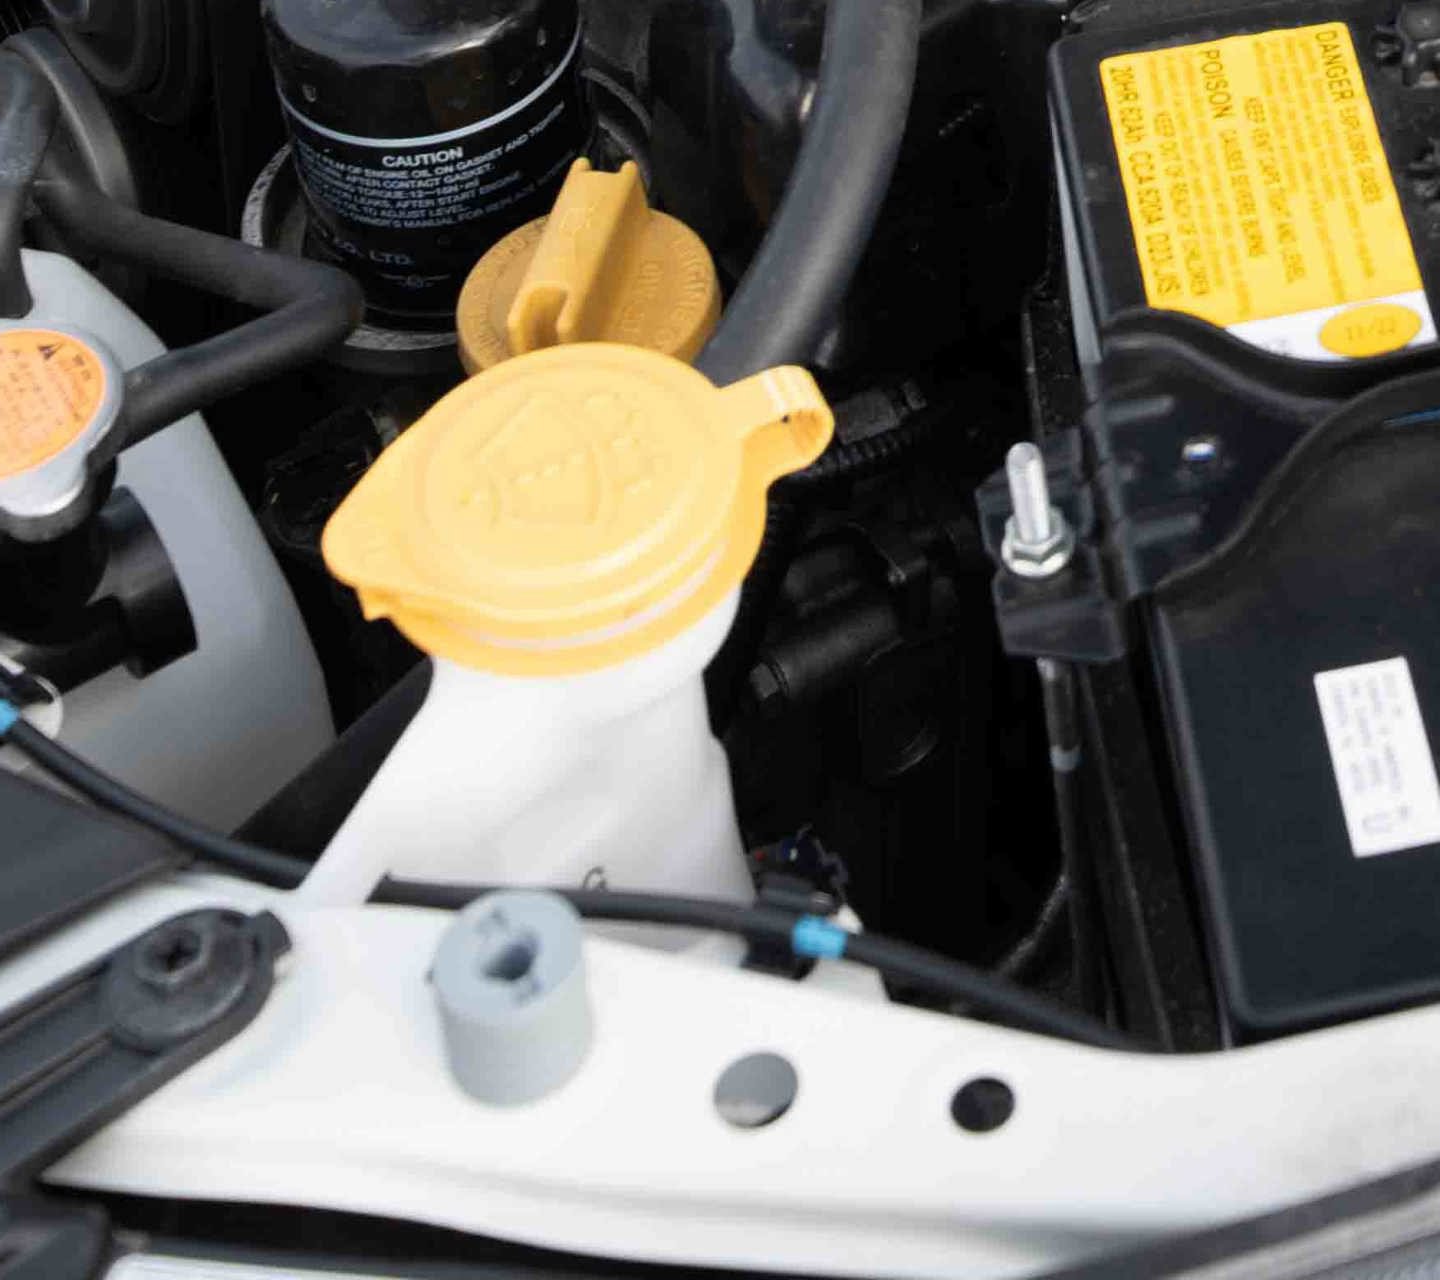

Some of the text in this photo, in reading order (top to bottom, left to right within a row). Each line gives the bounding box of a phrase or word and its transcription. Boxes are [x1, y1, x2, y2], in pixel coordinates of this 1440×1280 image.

[1316, 29, 1353, 102] DANGER
[1199, 47, 1234, 121] POISON
[381, 146, 464, 168] CAUTION
[411, 167, 432, 178] OIL
[434, 164, 454, 175] ON
[456, 146, 503, 170] GASKET
[1129, 149, 1156, 185] CCA
[345, 175, 381, 187] AFTER
[383, 177, 442, 189] CONTACT
[395, 198, 435, 209] AFTER
[437, 190, 476, 206] START
